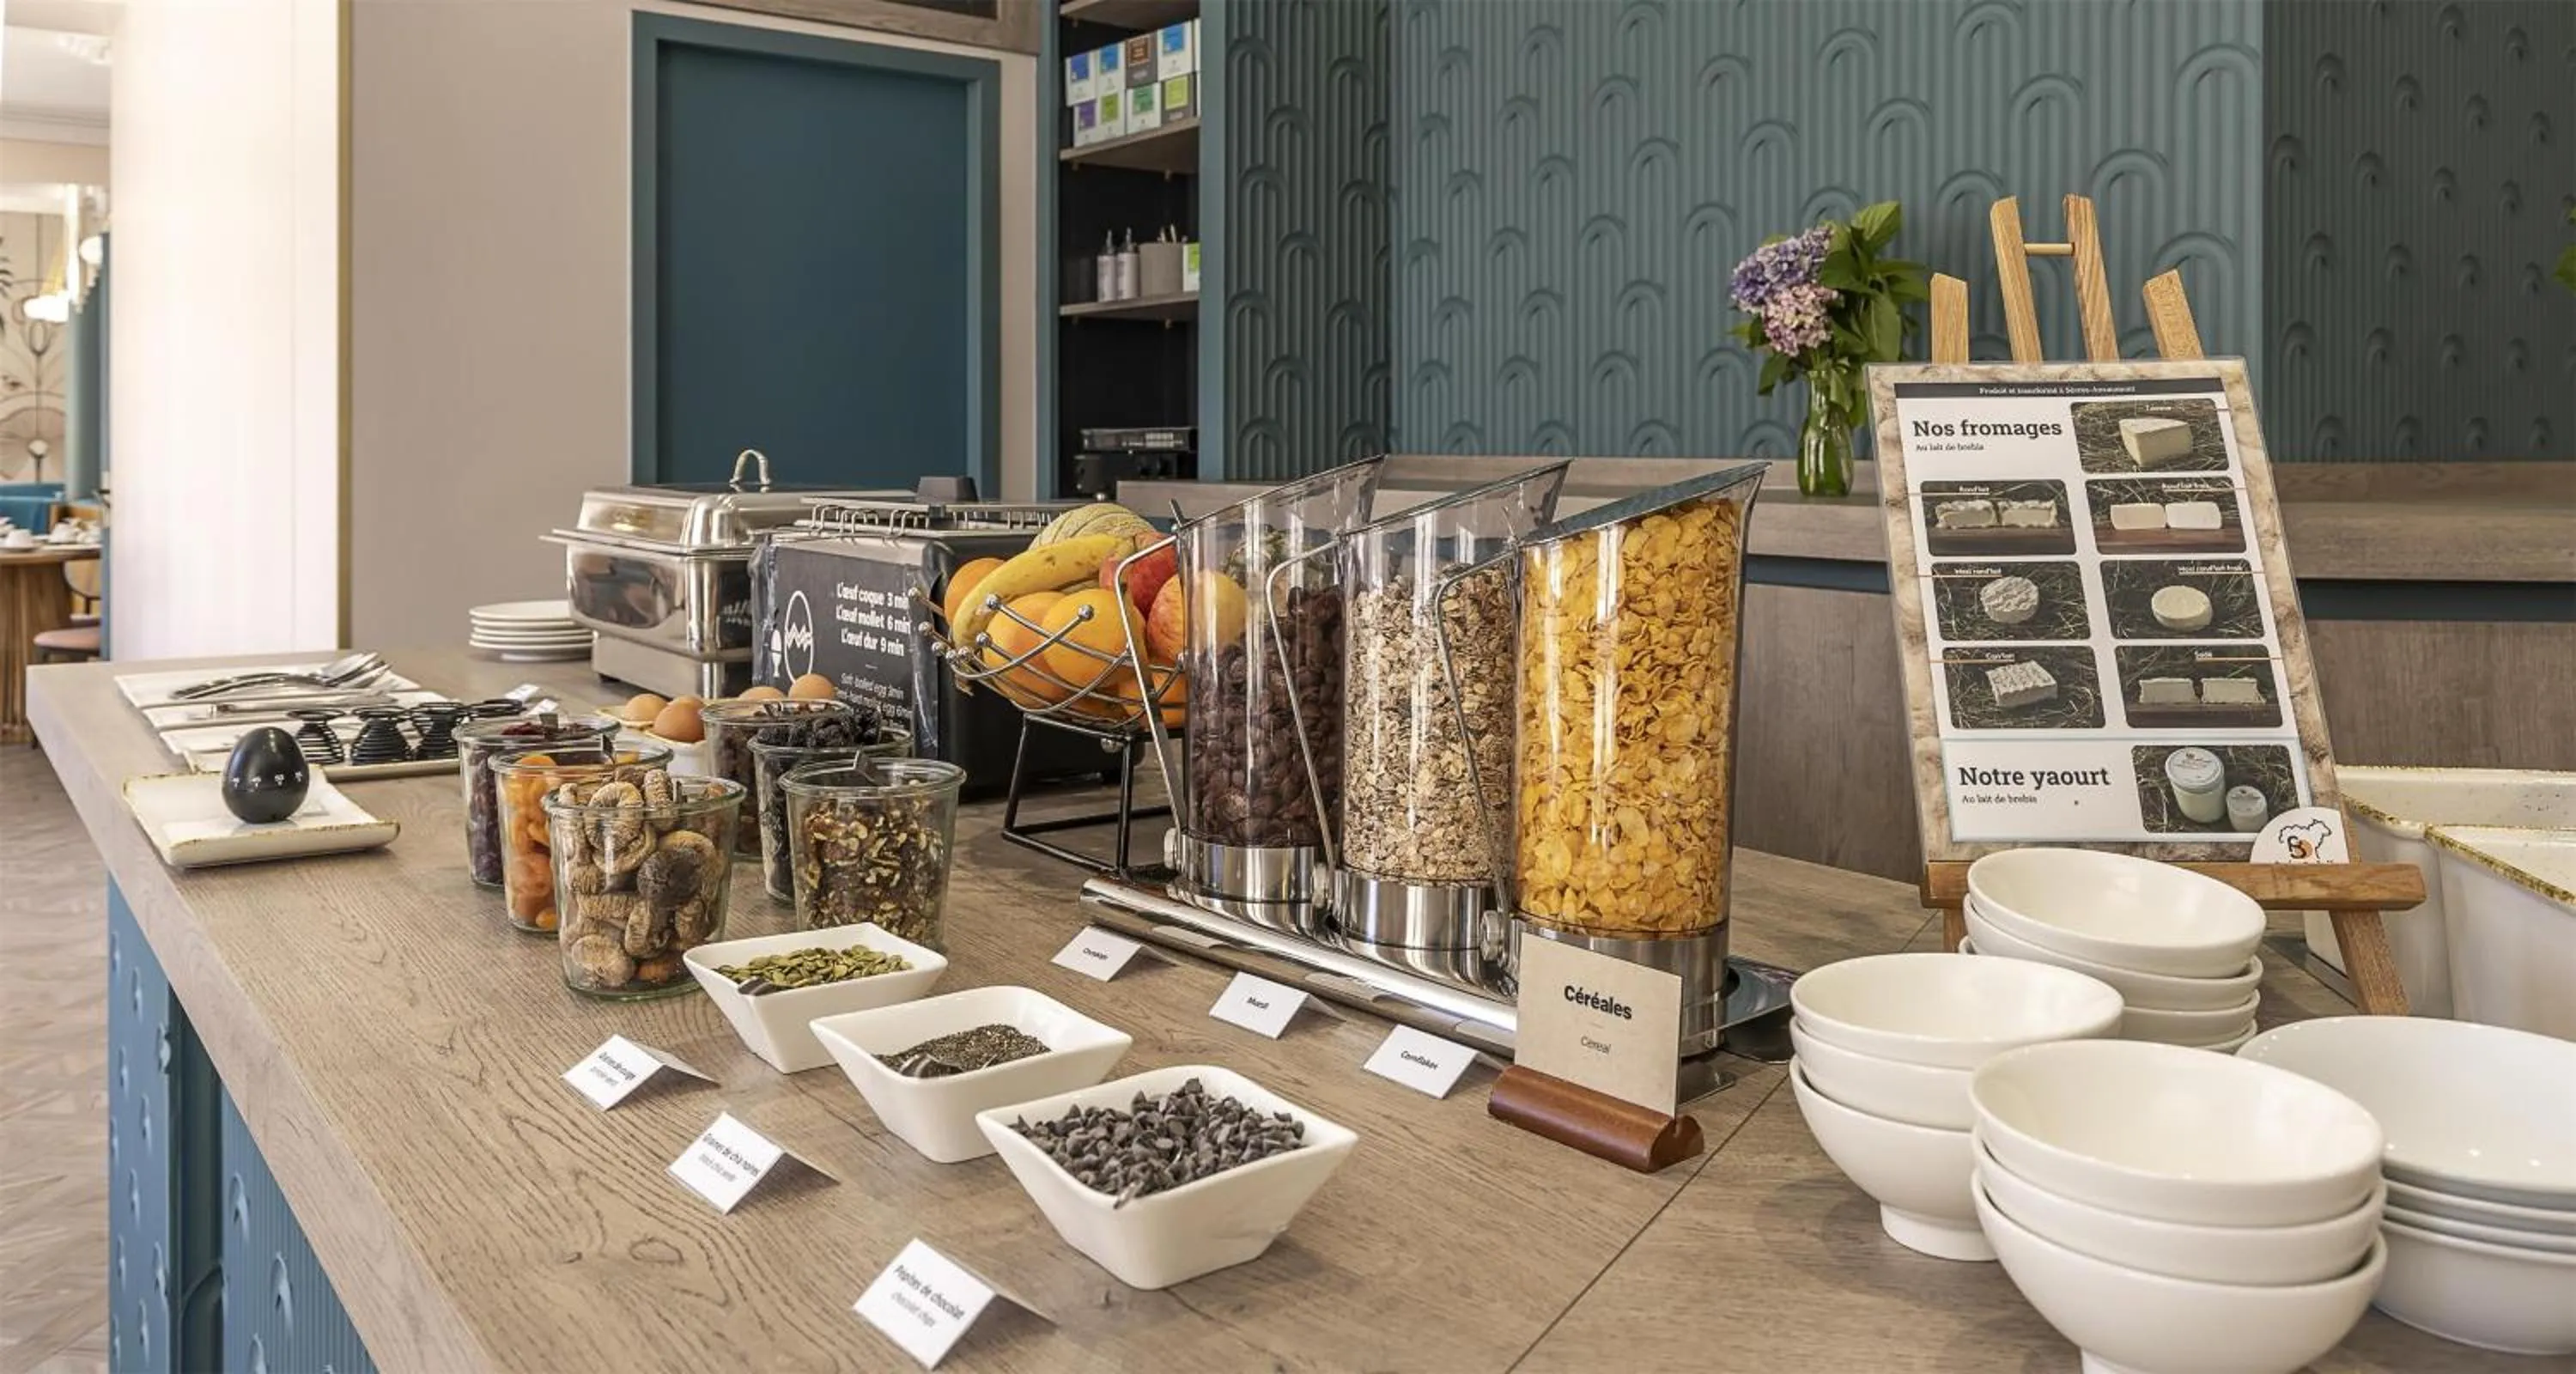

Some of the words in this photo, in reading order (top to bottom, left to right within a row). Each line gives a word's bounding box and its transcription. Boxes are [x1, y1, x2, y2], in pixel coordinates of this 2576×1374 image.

[1912, 420, 1955, 437] Nos
[1960, 418, 2063, 440] fromages
[859, 589, 884, 609] coque
[887, 592, 894, 607] 3
[859, 610, 885, 629] mollet
[887, 615, 894, 631] 6
[895, 616, 911, 635] min
[864, 631, 878, 650] dur
[880, 637, 887, 653] 9
[888, 638, 904, 657] min
[1958, 766, 2025, 786] Notre
[2029, 767, 2112, 790] yaourt
[1962, 794, 1975, 804] Au
[1977, 793, 1992, 803] lait
[1994, 793, 2006, 803] de
[1564, 985, 1632, 1020] Céréales
